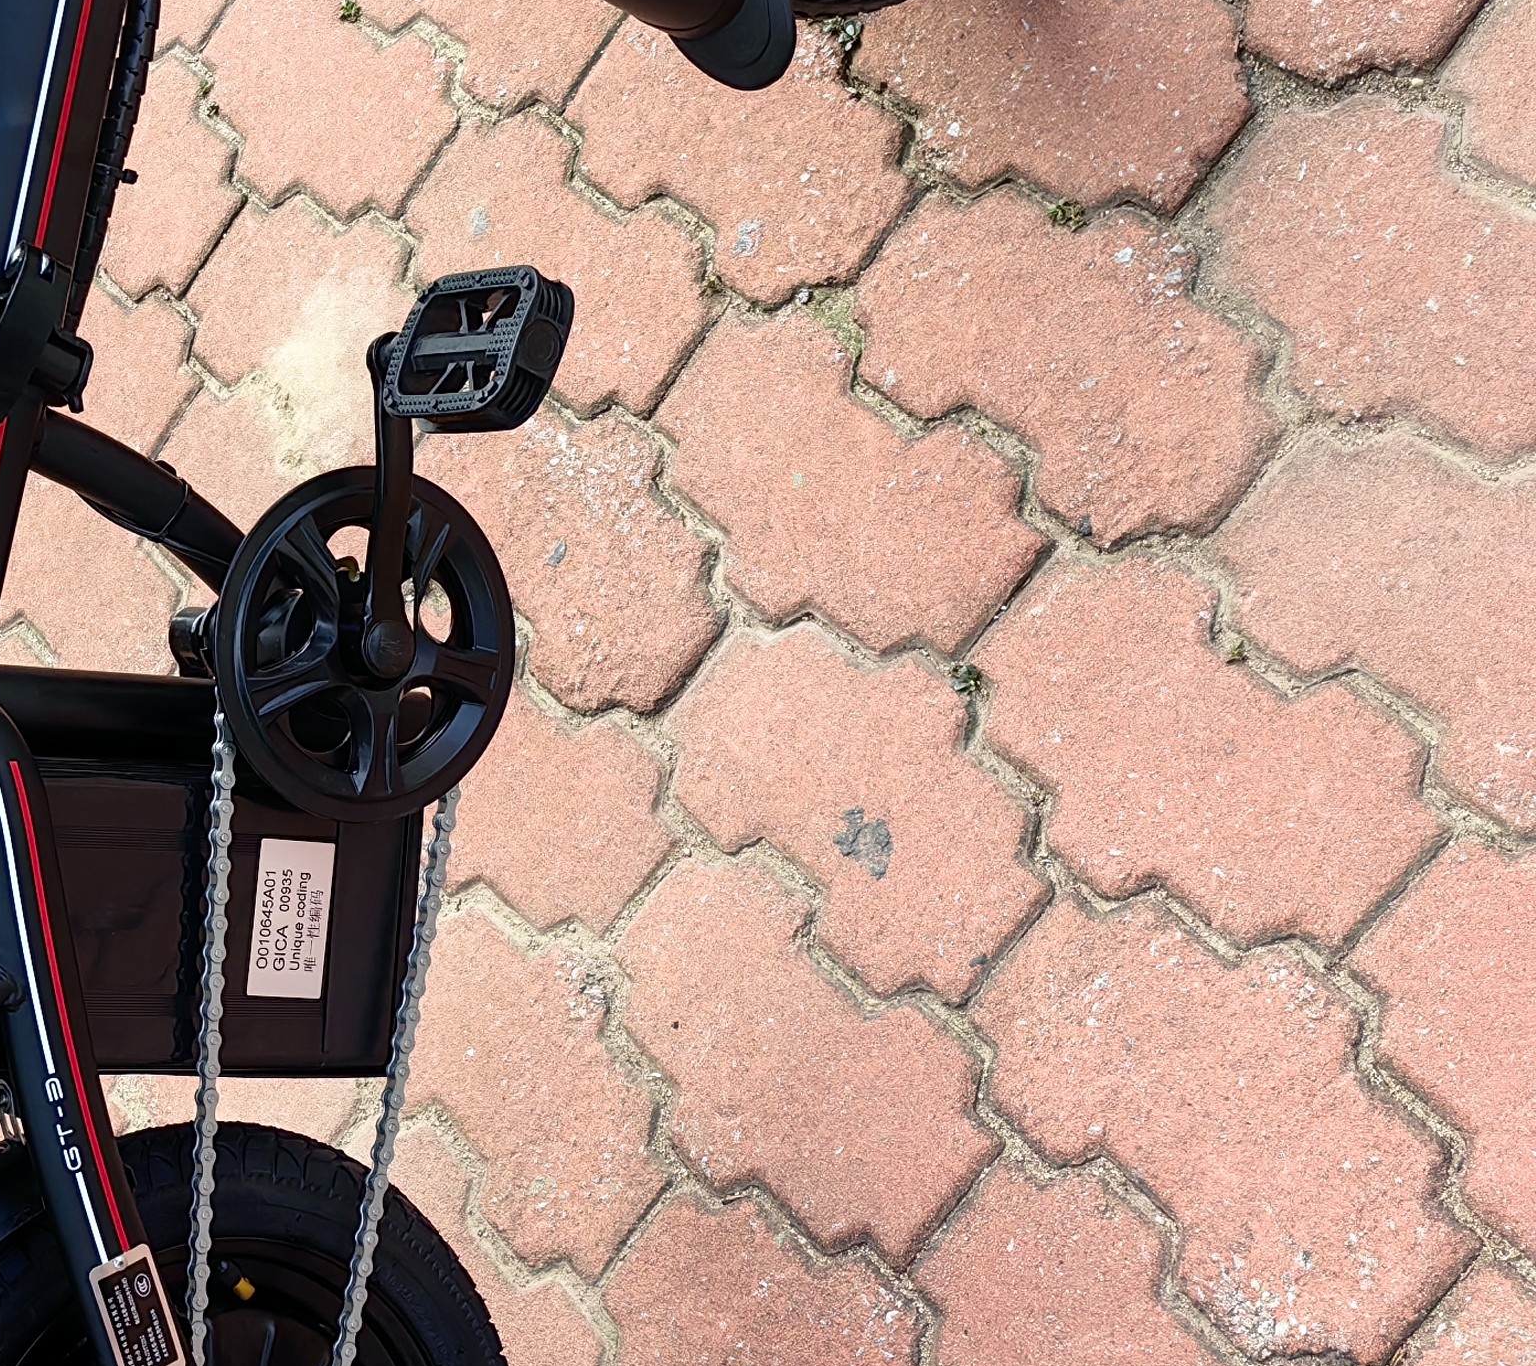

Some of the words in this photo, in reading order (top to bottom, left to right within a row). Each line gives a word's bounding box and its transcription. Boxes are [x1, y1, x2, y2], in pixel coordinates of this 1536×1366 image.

[279, 868, 293, 912] 00935
[296, 872, 311, 917] coding
[272, 925, 289, 972] GICA
[289, 922, 305, 971] Unique
[303, 889, 324, 973] 唯一性编码
[44, 1077, 82, 1171] GT-3
